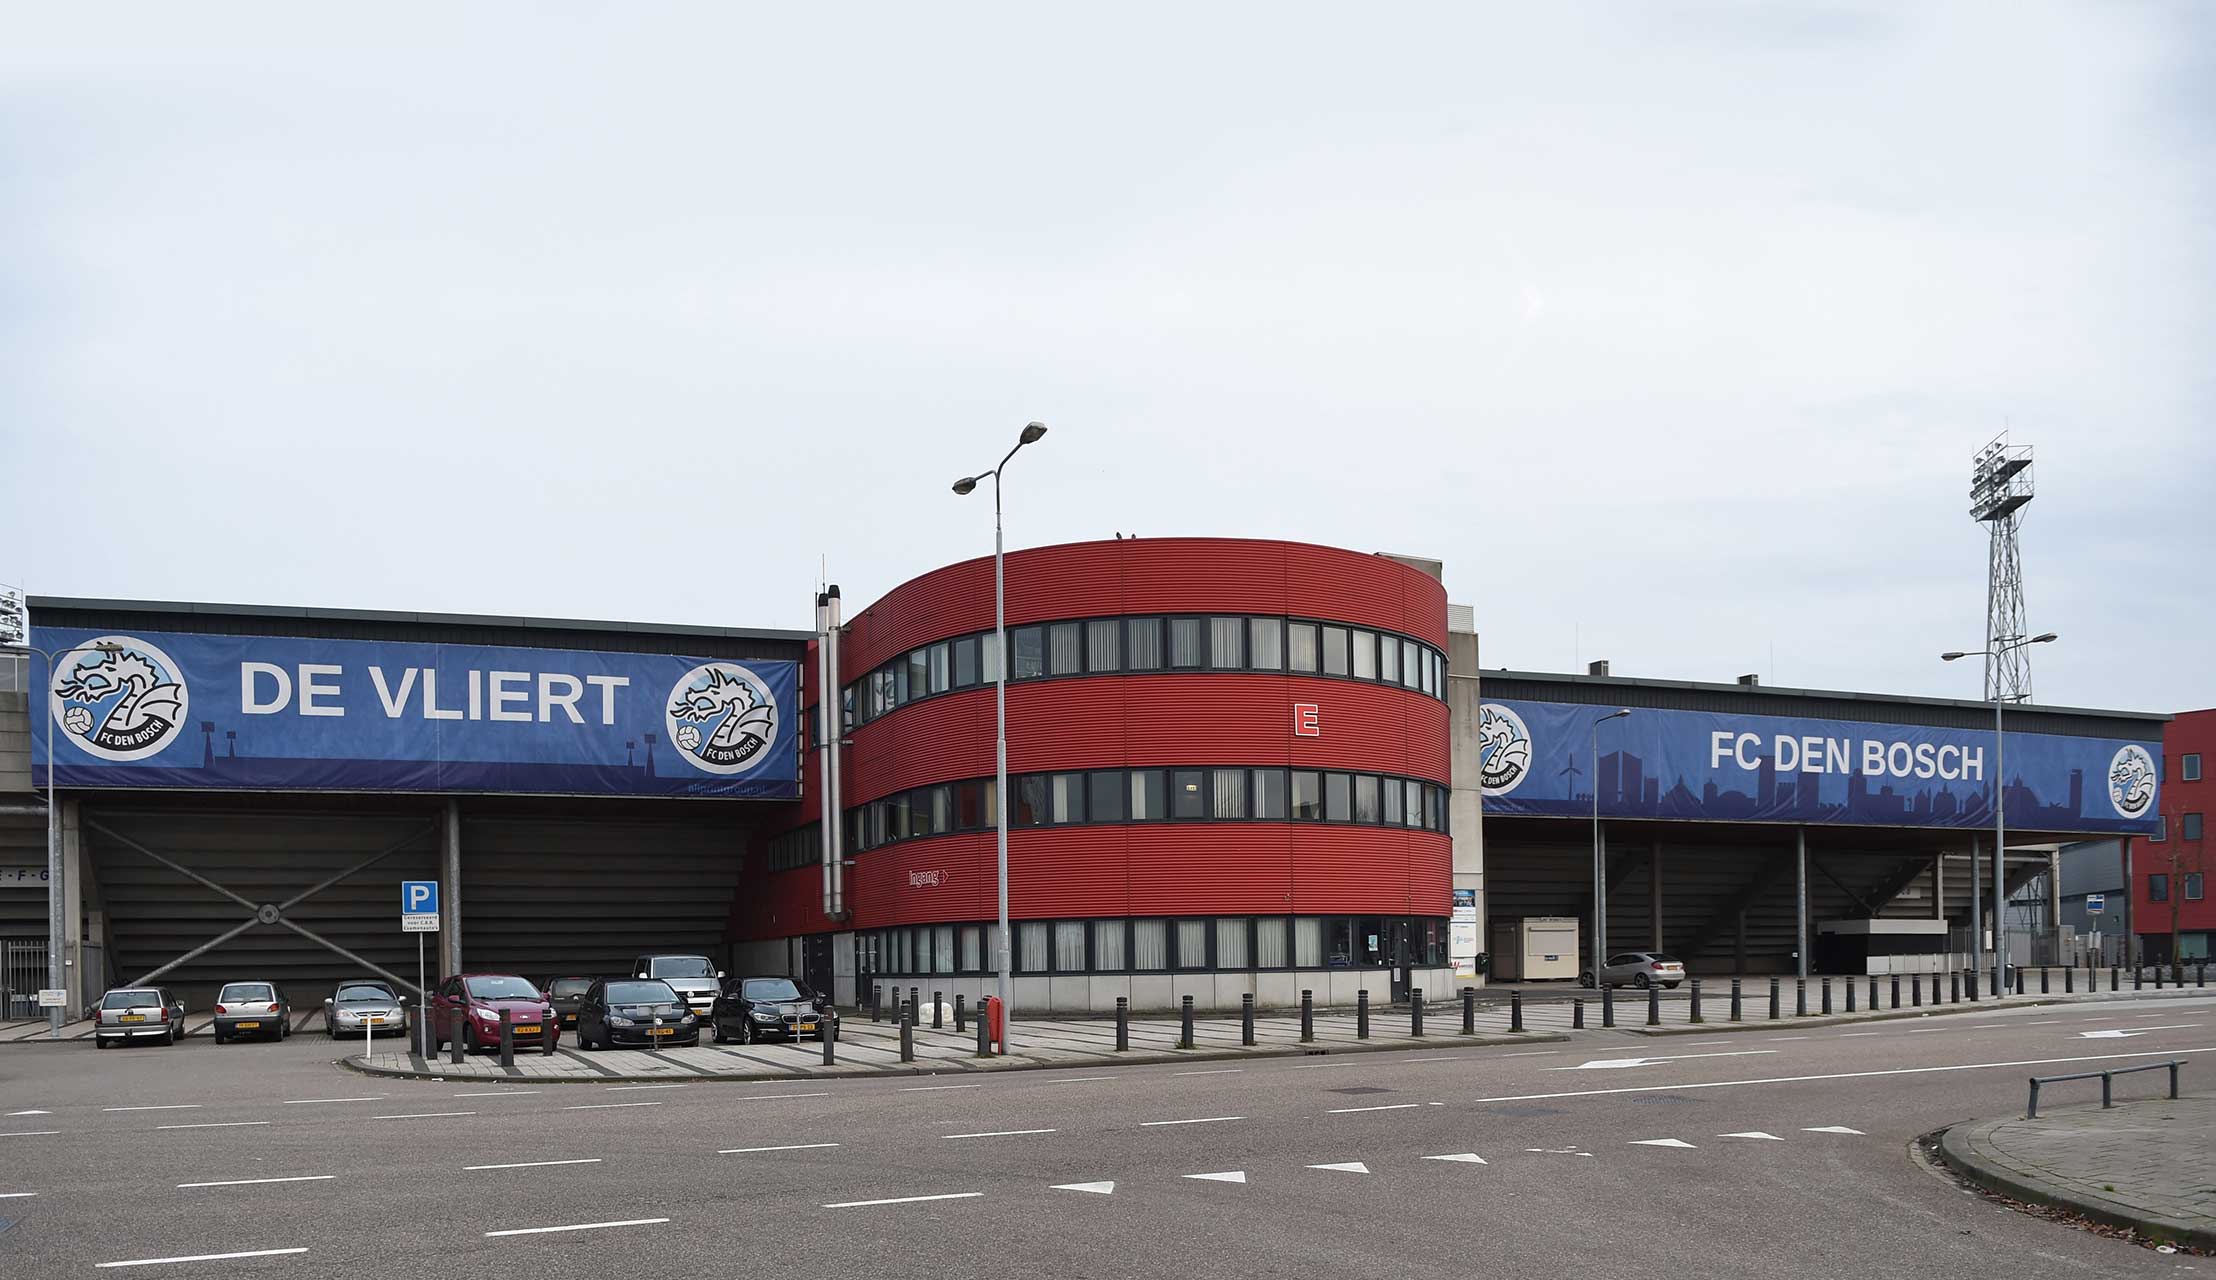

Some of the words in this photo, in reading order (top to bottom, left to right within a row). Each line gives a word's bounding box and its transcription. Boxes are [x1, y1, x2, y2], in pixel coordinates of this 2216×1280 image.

[240, 661, 345, 717] DE
[368, 665, 630, 725] VLIERT
[100, 732, 114, 745] FC
[114, 734, 135, 746] DEN
[134, 719, 164, 743] BOSCH
[1294, 703, 1320, 737] E
[706, 748, 718, 760] FC
[717, 750, 735, 761] DEN
[734, 736, 759, 758] BOSCH
[1711, 731, 1762, 770] FC
[1774, 734, 1850, 774] DEN
[1863, 740, 1984, 781] BOSCH
[1500, 766, 1517, 782] BOSCH
[909, 870, 940, 888] Ingang
[411, 885, 430, 910] P
